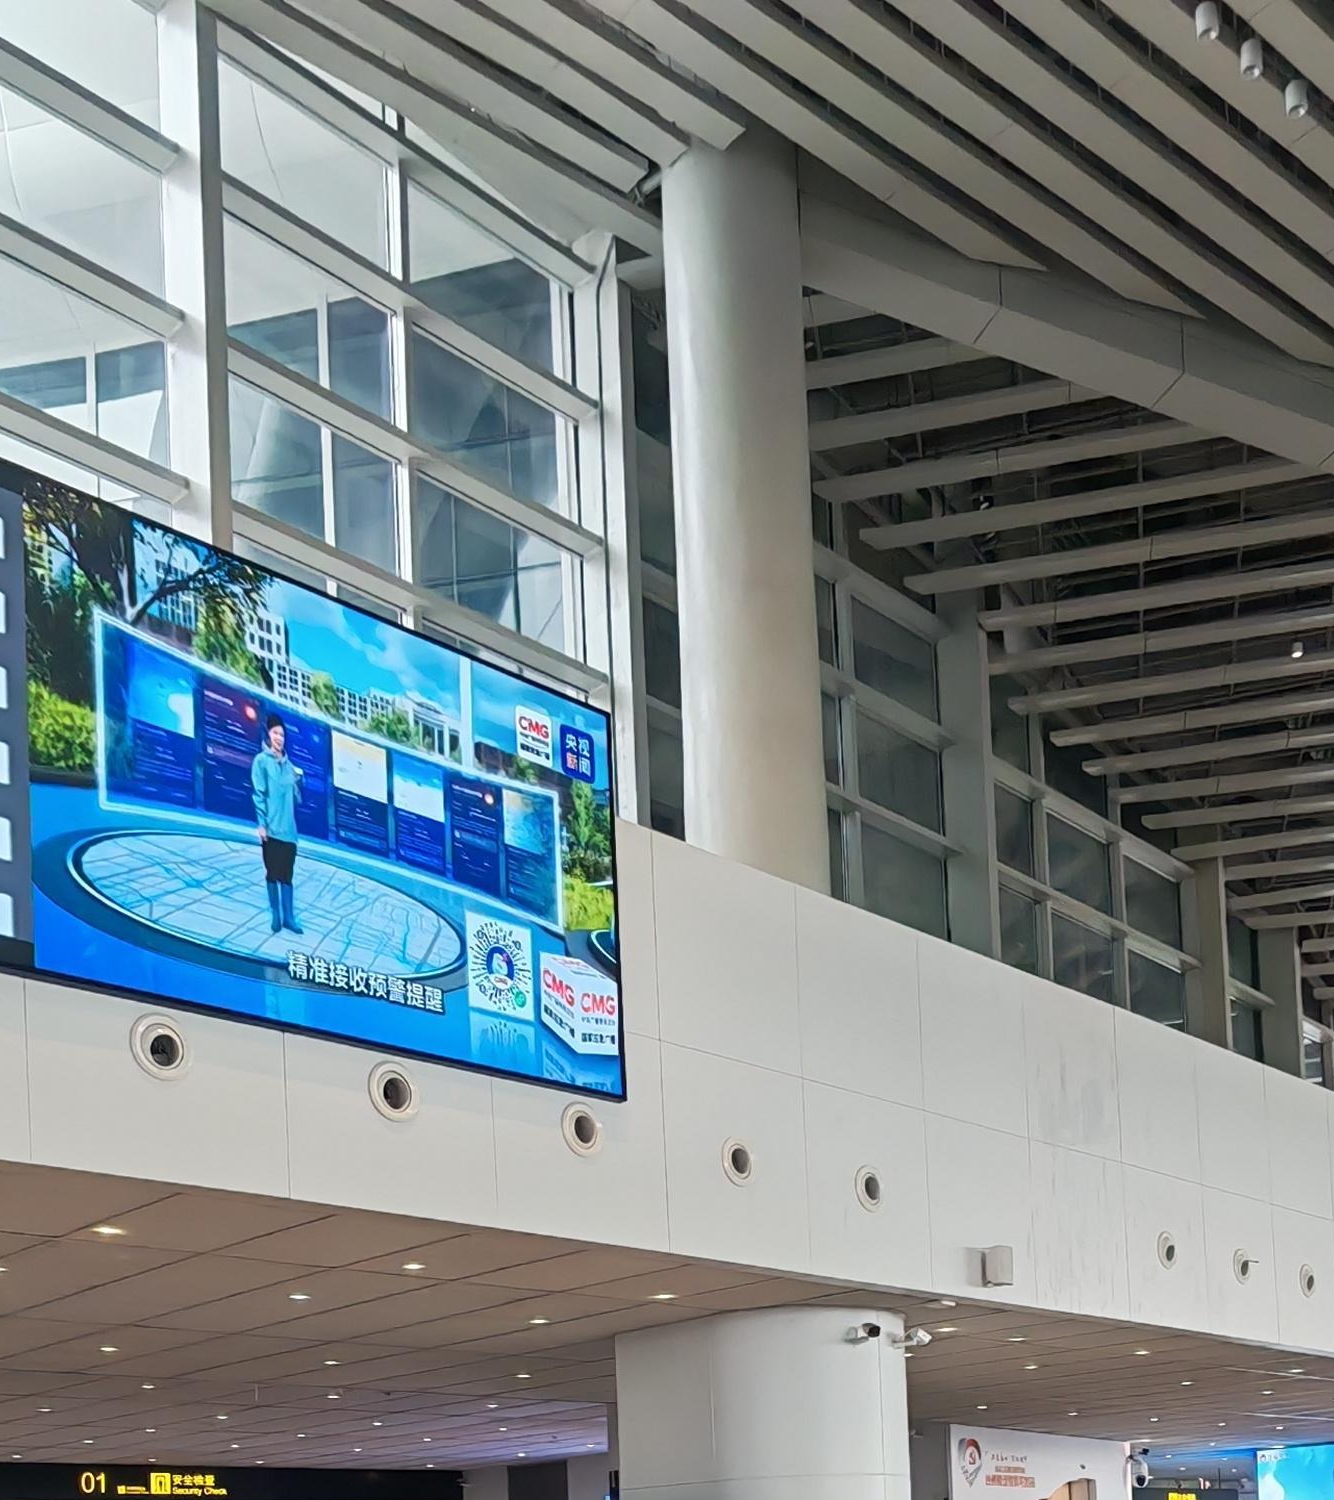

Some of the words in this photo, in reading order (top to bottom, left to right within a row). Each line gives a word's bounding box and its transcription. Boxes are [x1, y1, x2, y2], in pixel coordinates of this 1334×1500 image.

[519, 716, 549, 739] CMG
[287, 951, 444, 1013] 精准接收预警提醒
[543, 968, 575, 1007] CMG
[581, 993, 616, 1016] CMG
[81, 1472, 106, 1493] 01
[172, 1474, 215, 1486] 安全检查
